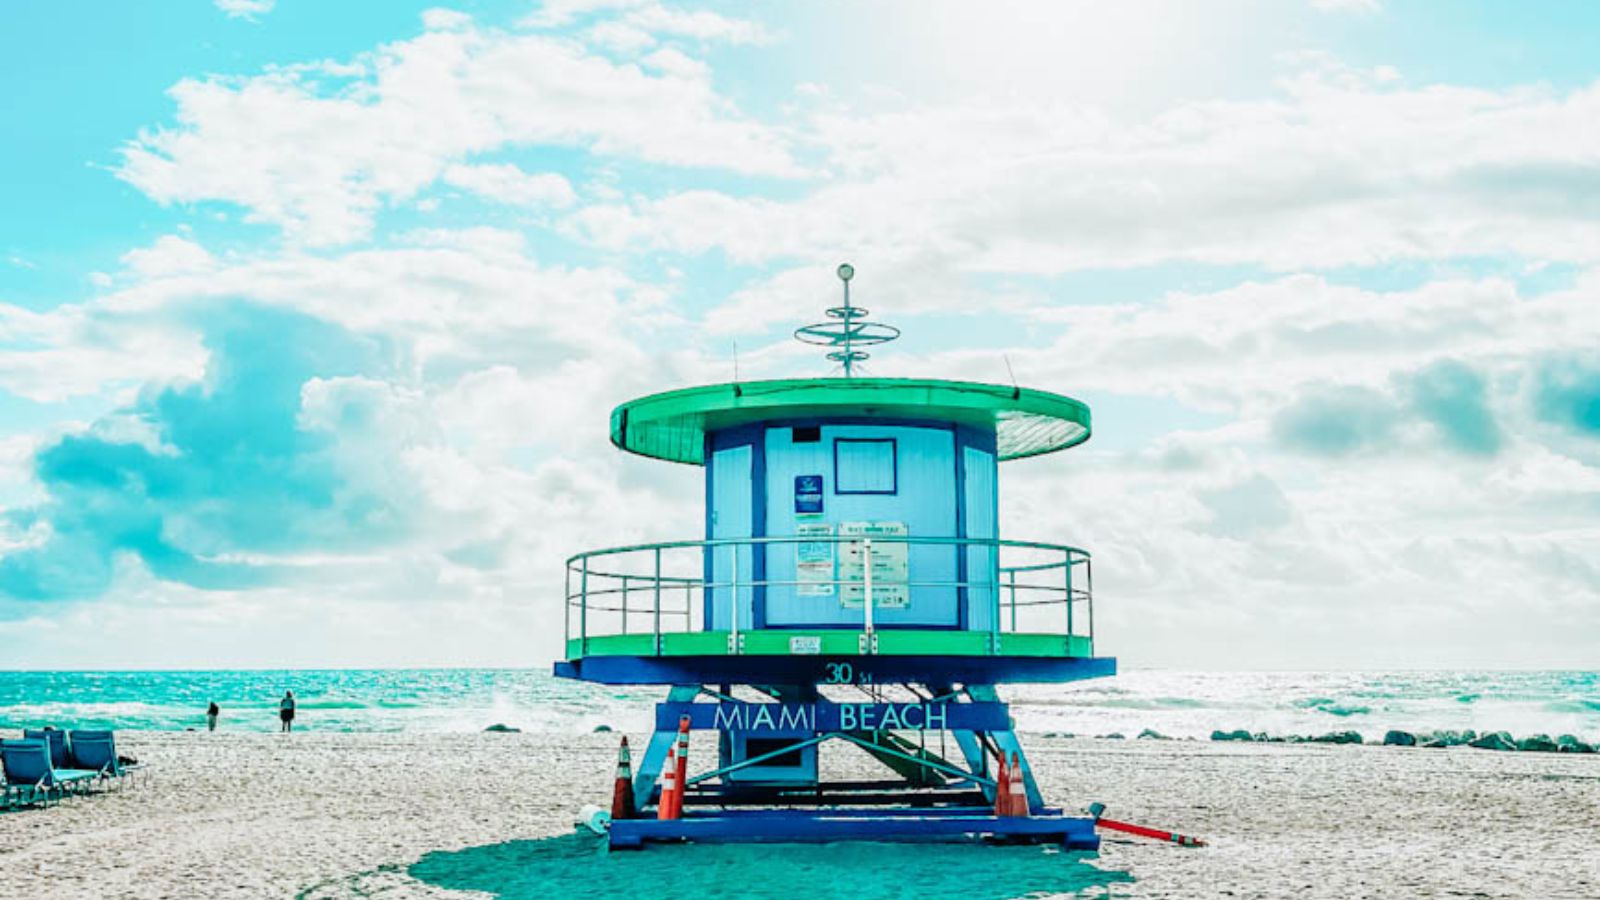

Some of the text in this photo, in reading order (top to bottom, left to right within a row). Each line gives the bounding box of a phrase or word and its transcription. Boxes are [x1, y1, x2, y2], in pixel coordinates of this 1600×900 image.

[825, 662, 852, 684] 30
[713, 704, 947, 730] MIAMI BEACH
